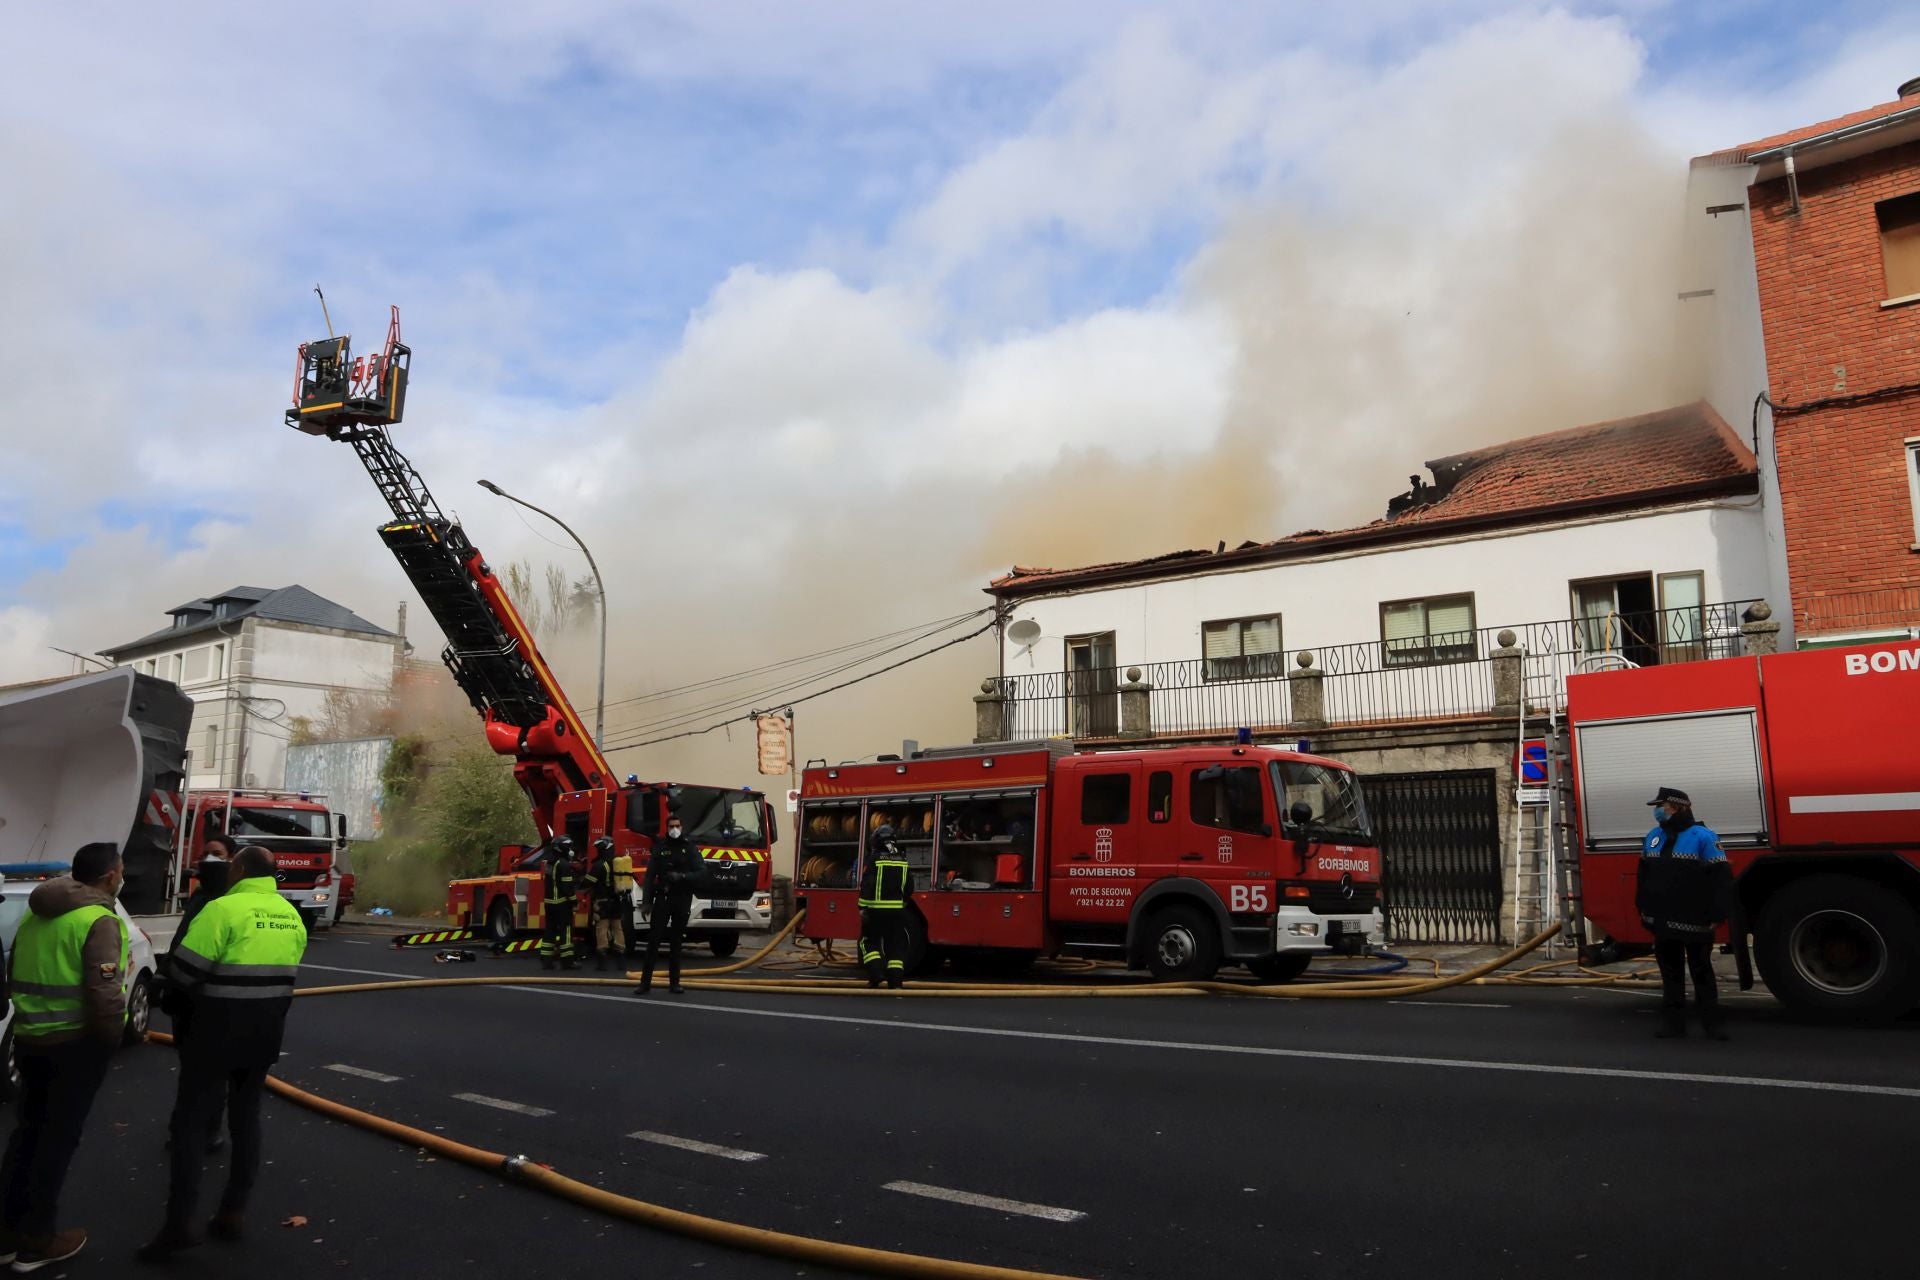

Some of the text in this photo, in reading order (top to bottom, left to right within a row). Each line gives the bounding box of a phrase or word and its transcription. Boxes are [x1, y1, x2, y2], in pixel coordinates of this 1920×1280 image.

[1845, 648, 1920, 675] BOM
[1069, 867, 1136, 877] BOMBEROS
[1069, 887, 1132, 896] AYTO. DE SEGOVIA
[1081, 898, 1125, 907] 921 42 22 22
[1230, 885, 1268, 912] B5
[256, 921, 298, 931] El Espinar
